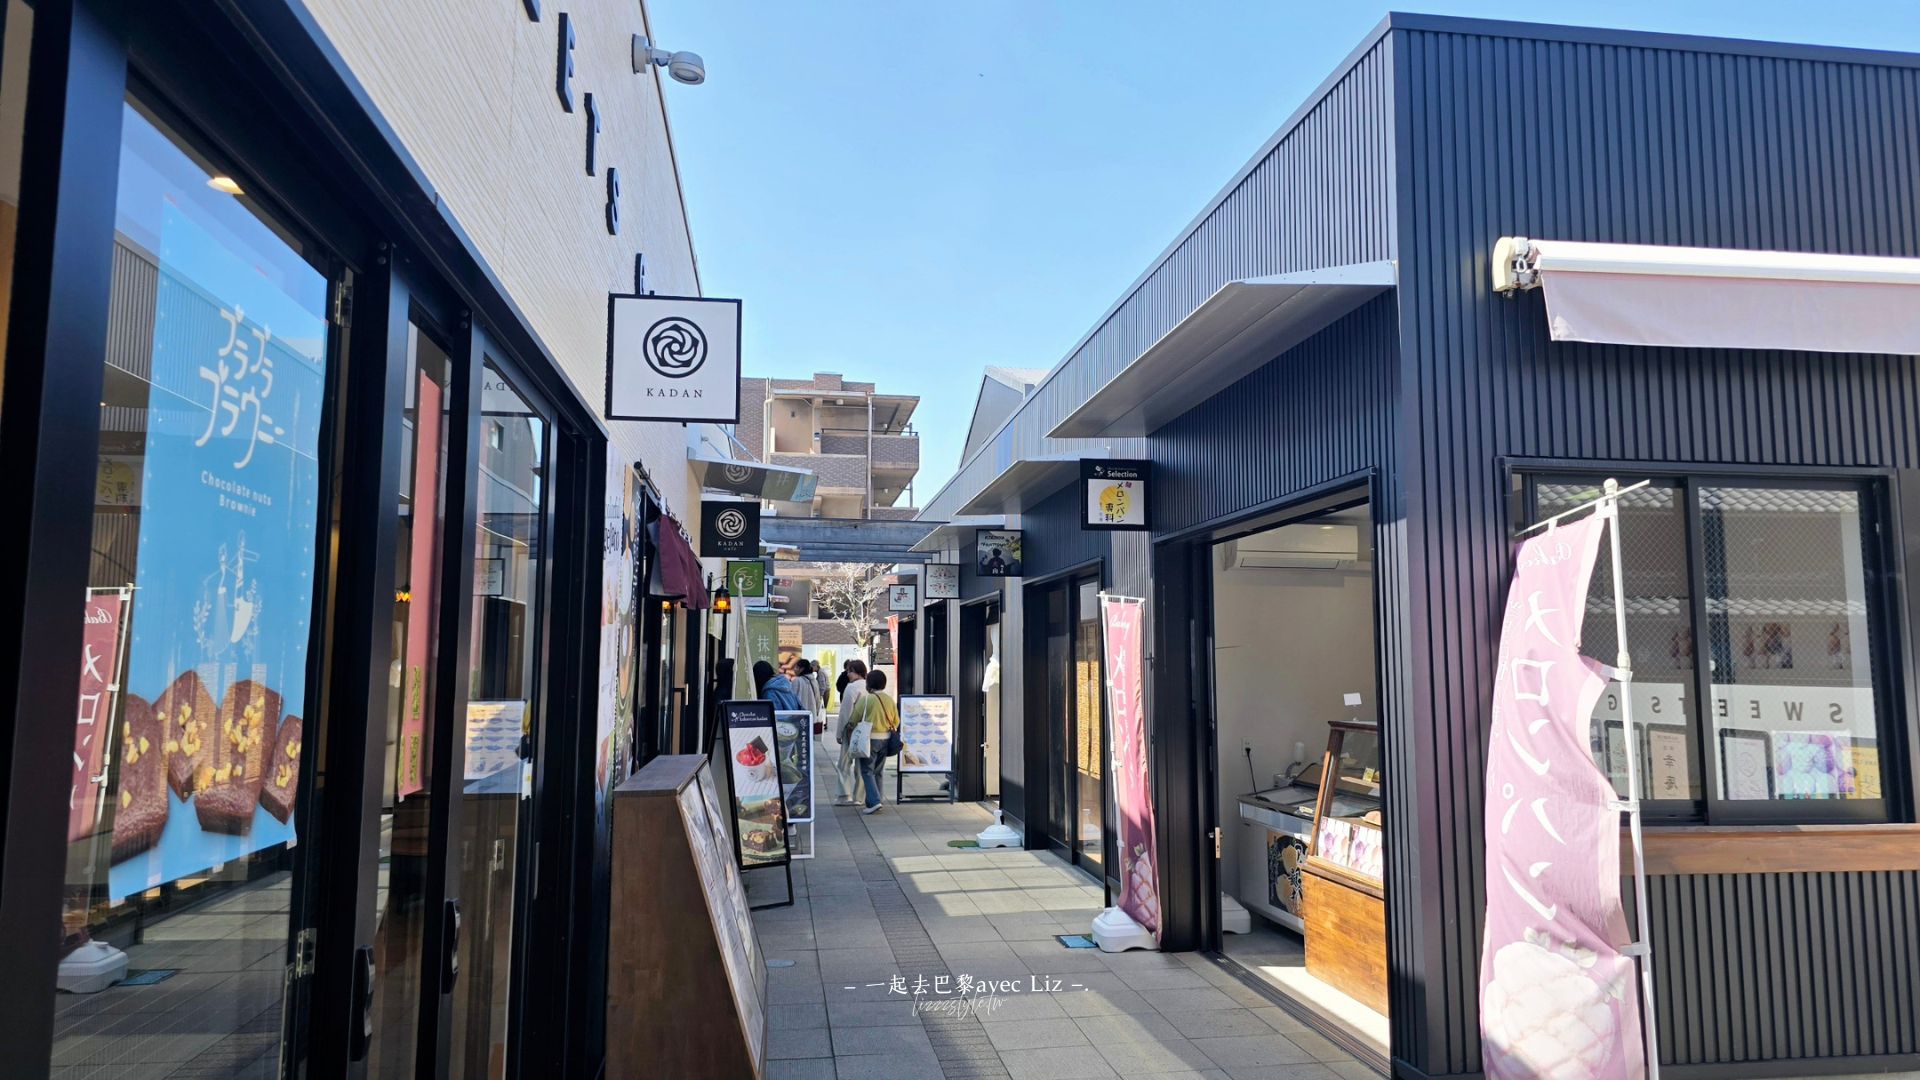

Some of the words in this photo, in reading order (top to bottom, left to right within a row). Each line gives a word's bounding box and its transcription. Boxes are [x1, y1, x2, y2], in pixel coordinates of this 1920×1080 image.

[646, 387, 703, 398] KADAN
[1107, 470, 1138, 478] Selection
[201, 470, 251, 498] Chocolate
[252, 491, 273, 506] nuts
[219, 493, 257, 517] Brownie
